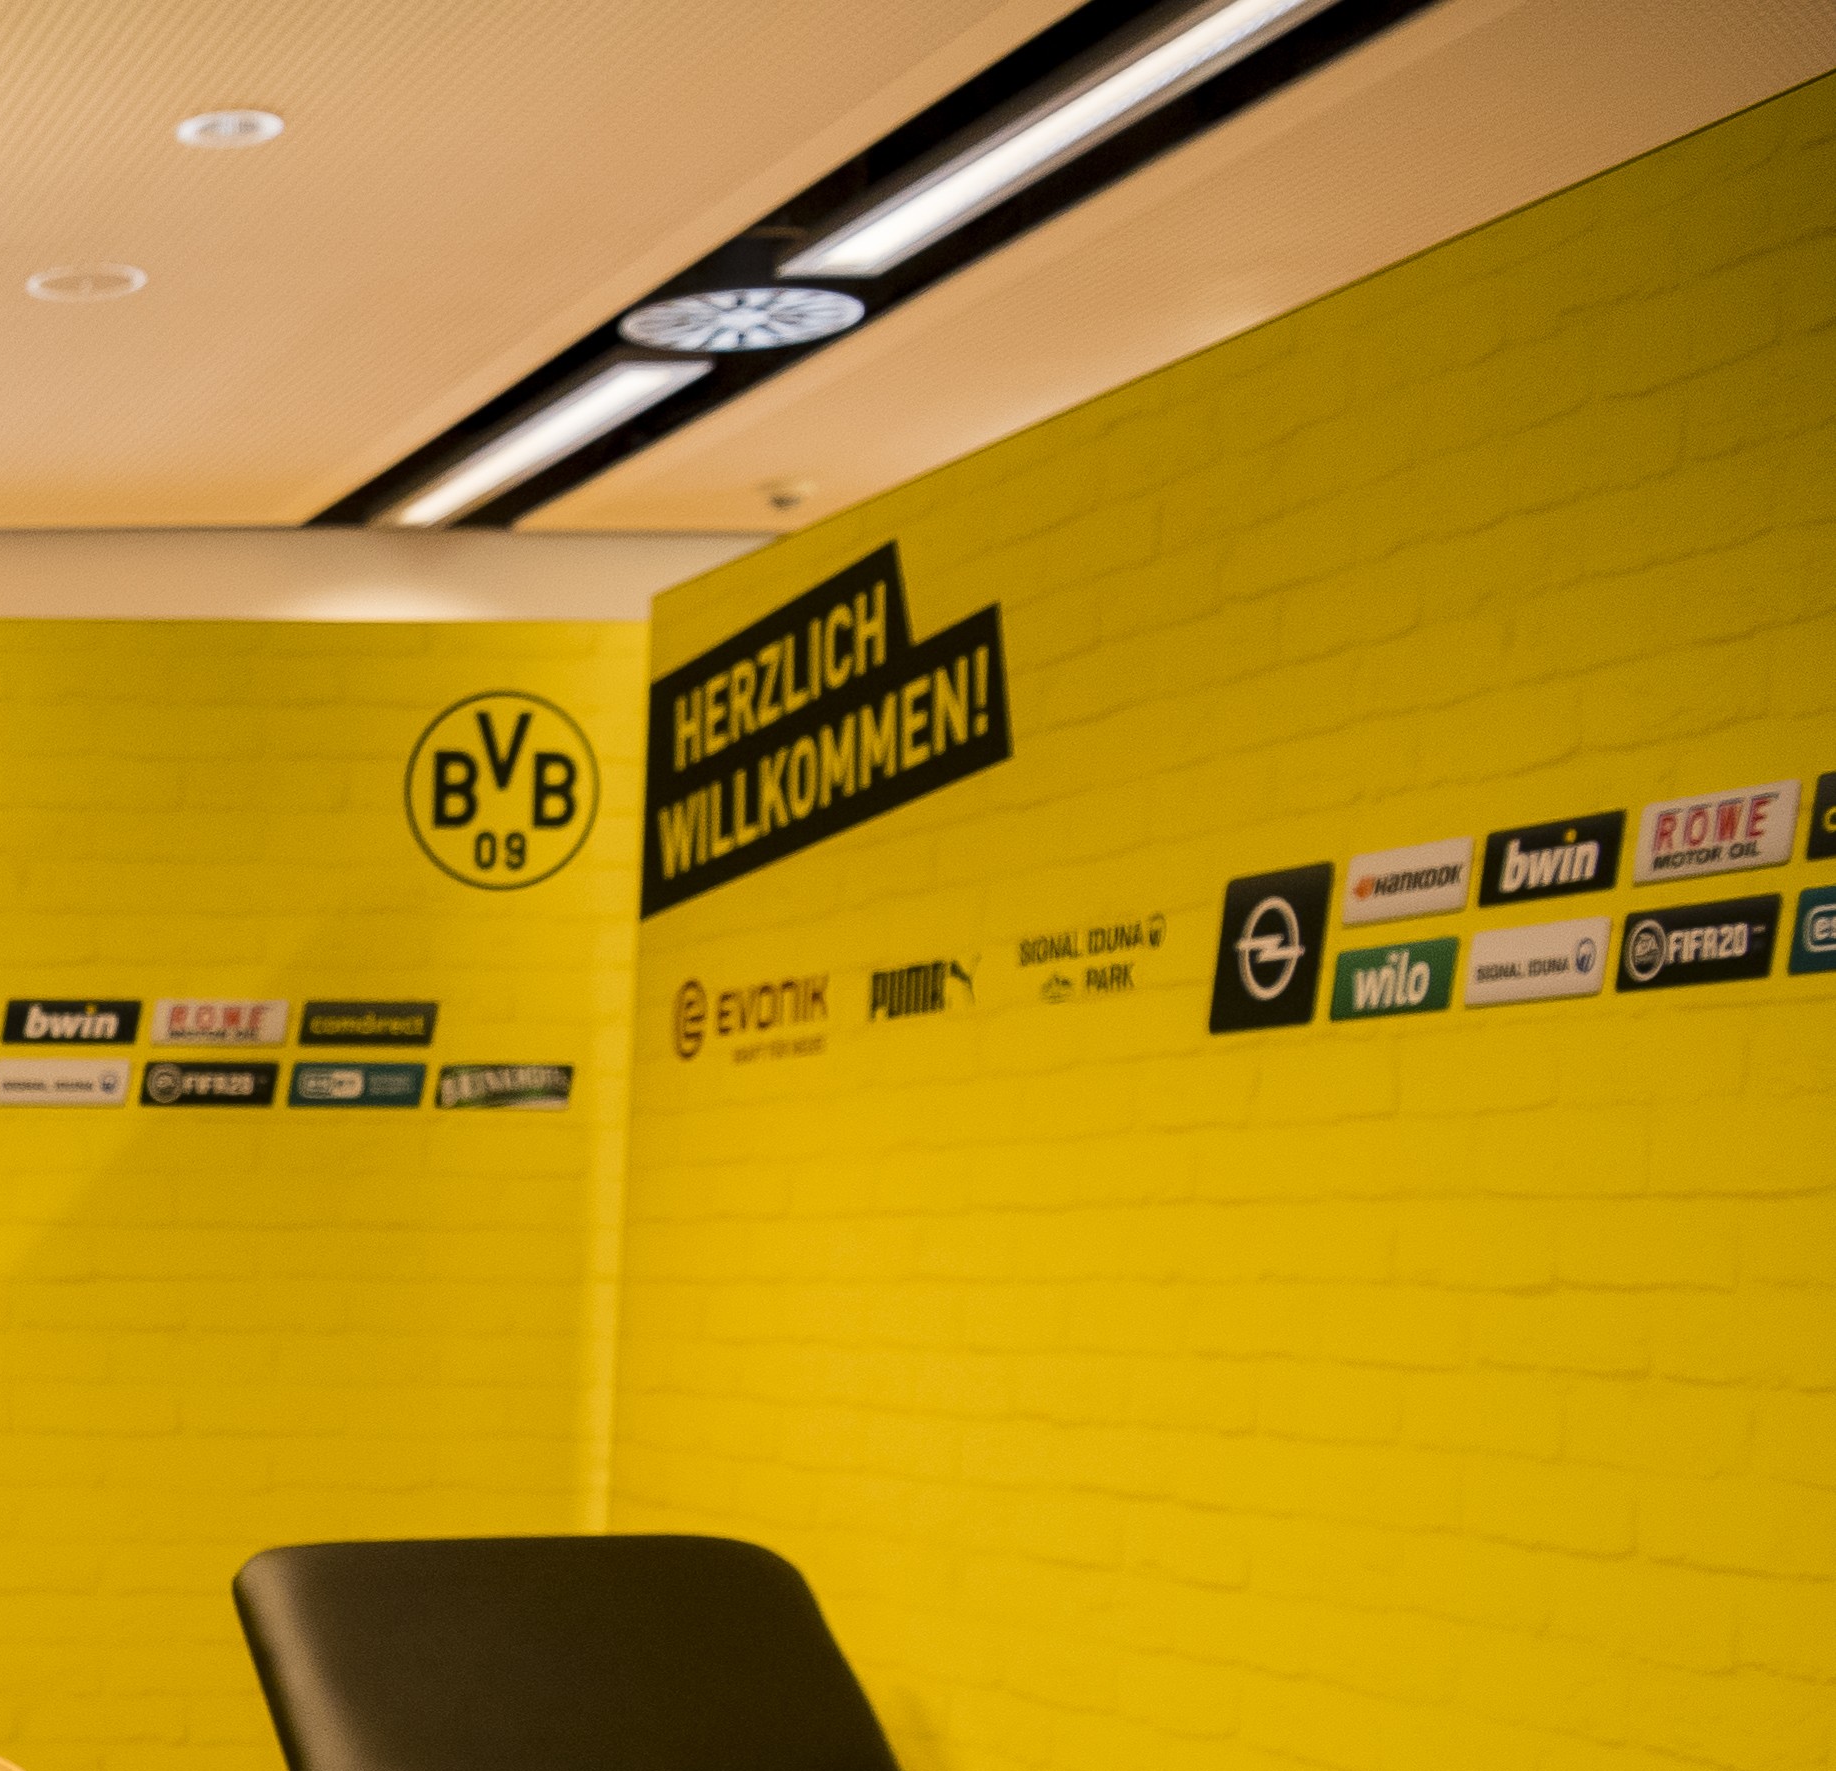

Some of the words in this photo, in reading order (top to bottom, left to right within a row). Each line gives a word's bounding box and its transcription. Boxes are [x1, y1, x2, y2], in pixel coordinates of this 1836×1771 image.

[673, 580, 888, 772] HERZLICH
[433, 710, 577, 829] BVB
[656, 644, 990, 881] WILLKOMMEN!
[474, 831, 526, 870] 09
[1500, 829, 1600, 893] bwin
[1018, 931, 1082, 968] SIGNAL
[1088, 922, 1144, 957] IDUNA
[1085, 963, 1136, 993] PARK
[1353, 950, 1431, 1011] wilo
[23, 1003, 119, 1039] bwin
